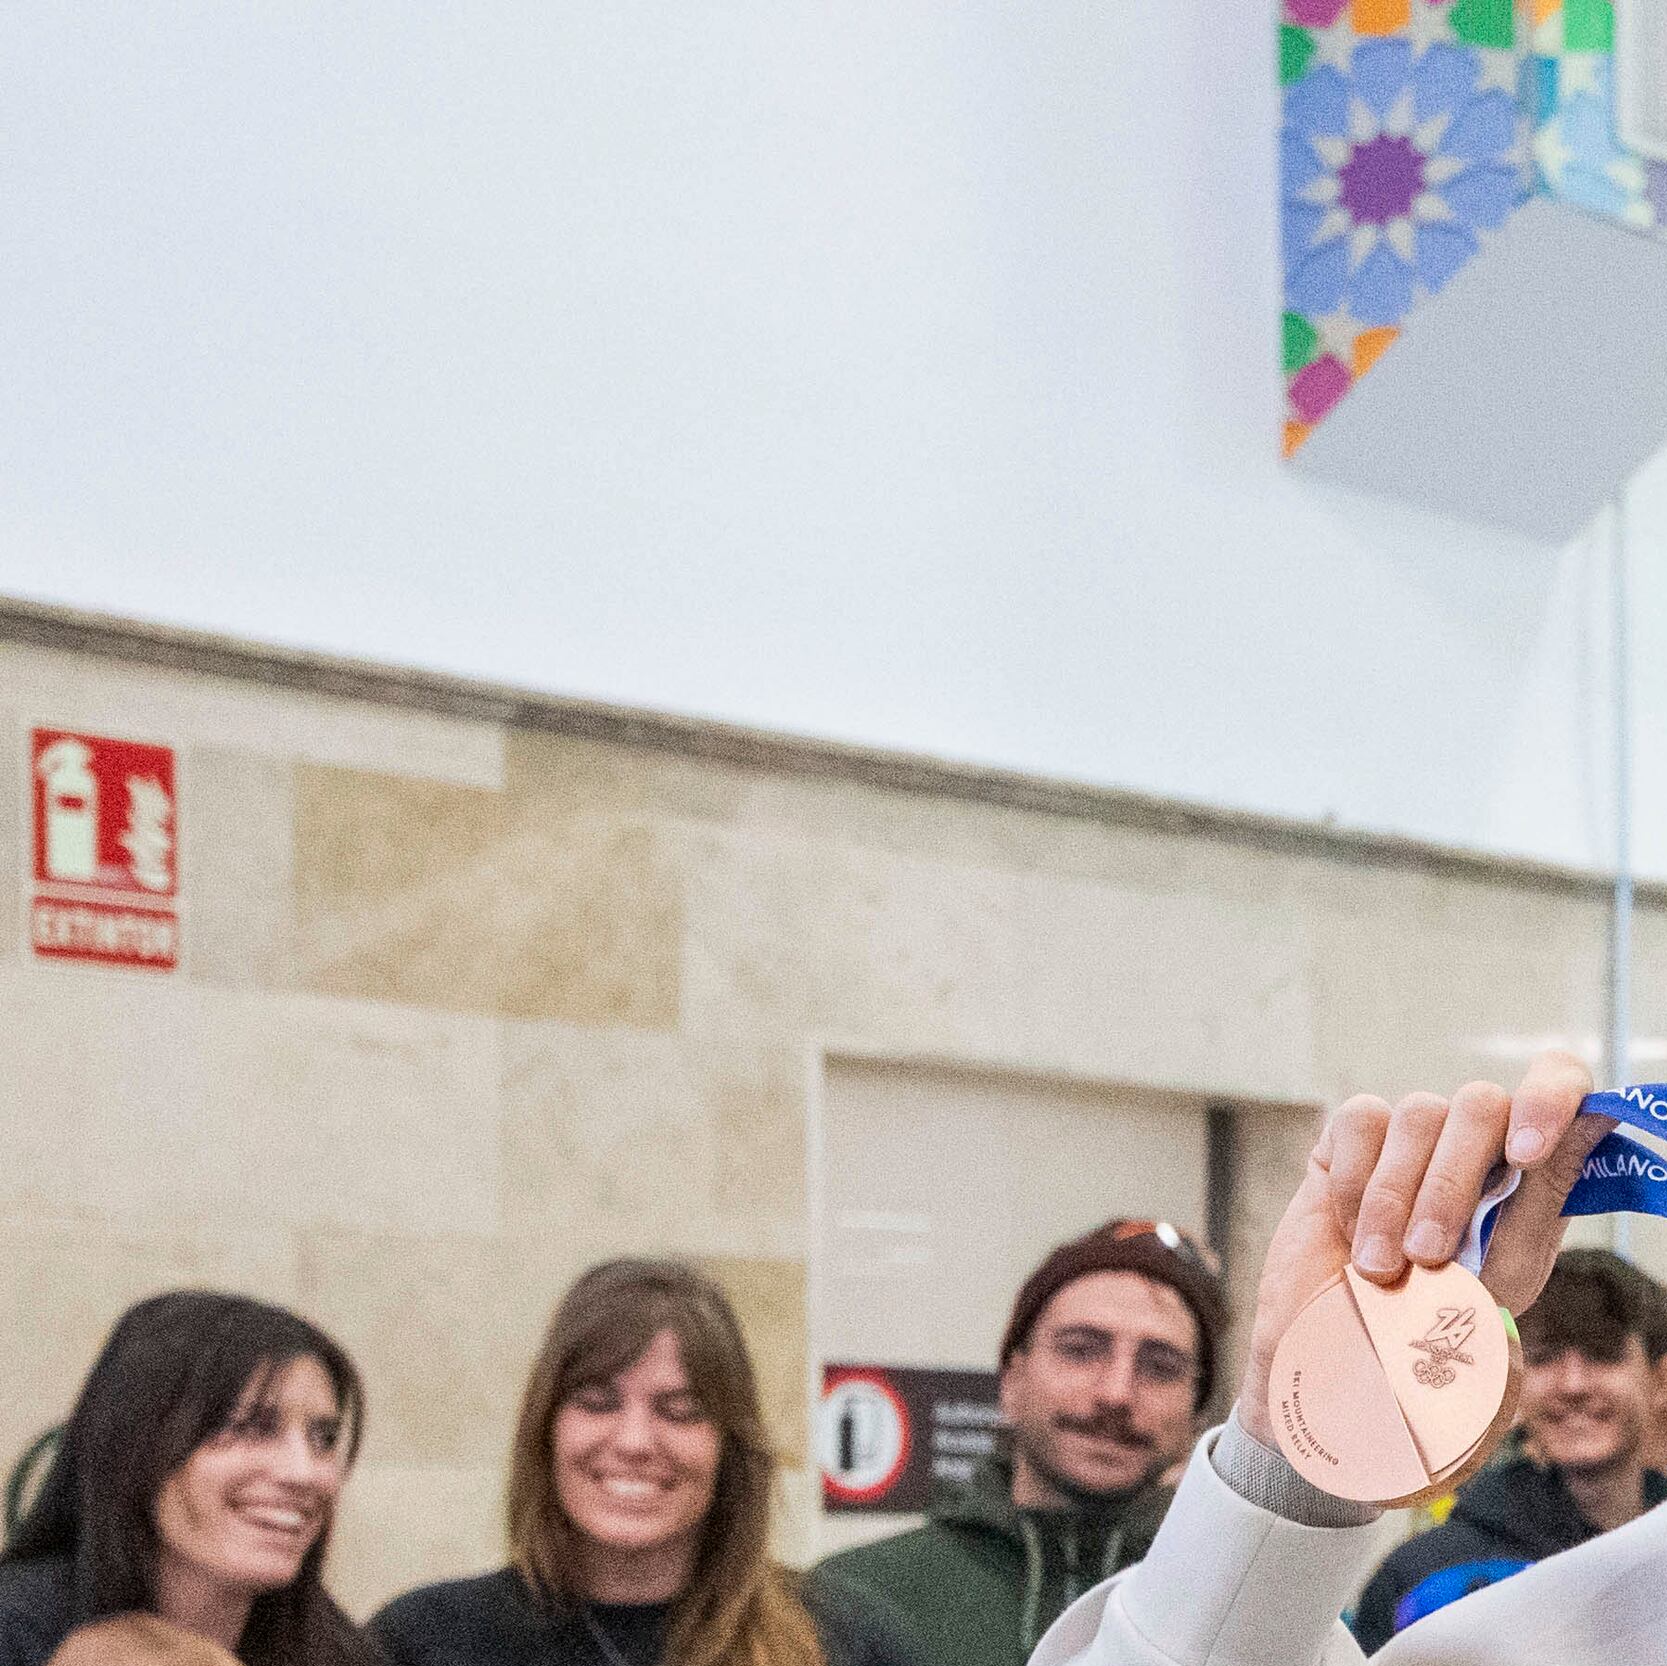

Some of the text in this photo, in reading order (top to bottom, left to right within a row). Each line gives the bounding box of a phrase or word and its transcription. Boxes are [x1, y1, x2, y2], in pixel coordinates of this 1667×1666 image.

[1281, 1400, 1312, 1460] MIXED RELAY
[1292, 1370, 1339, 1465] SKI MOUNTAINEERING
